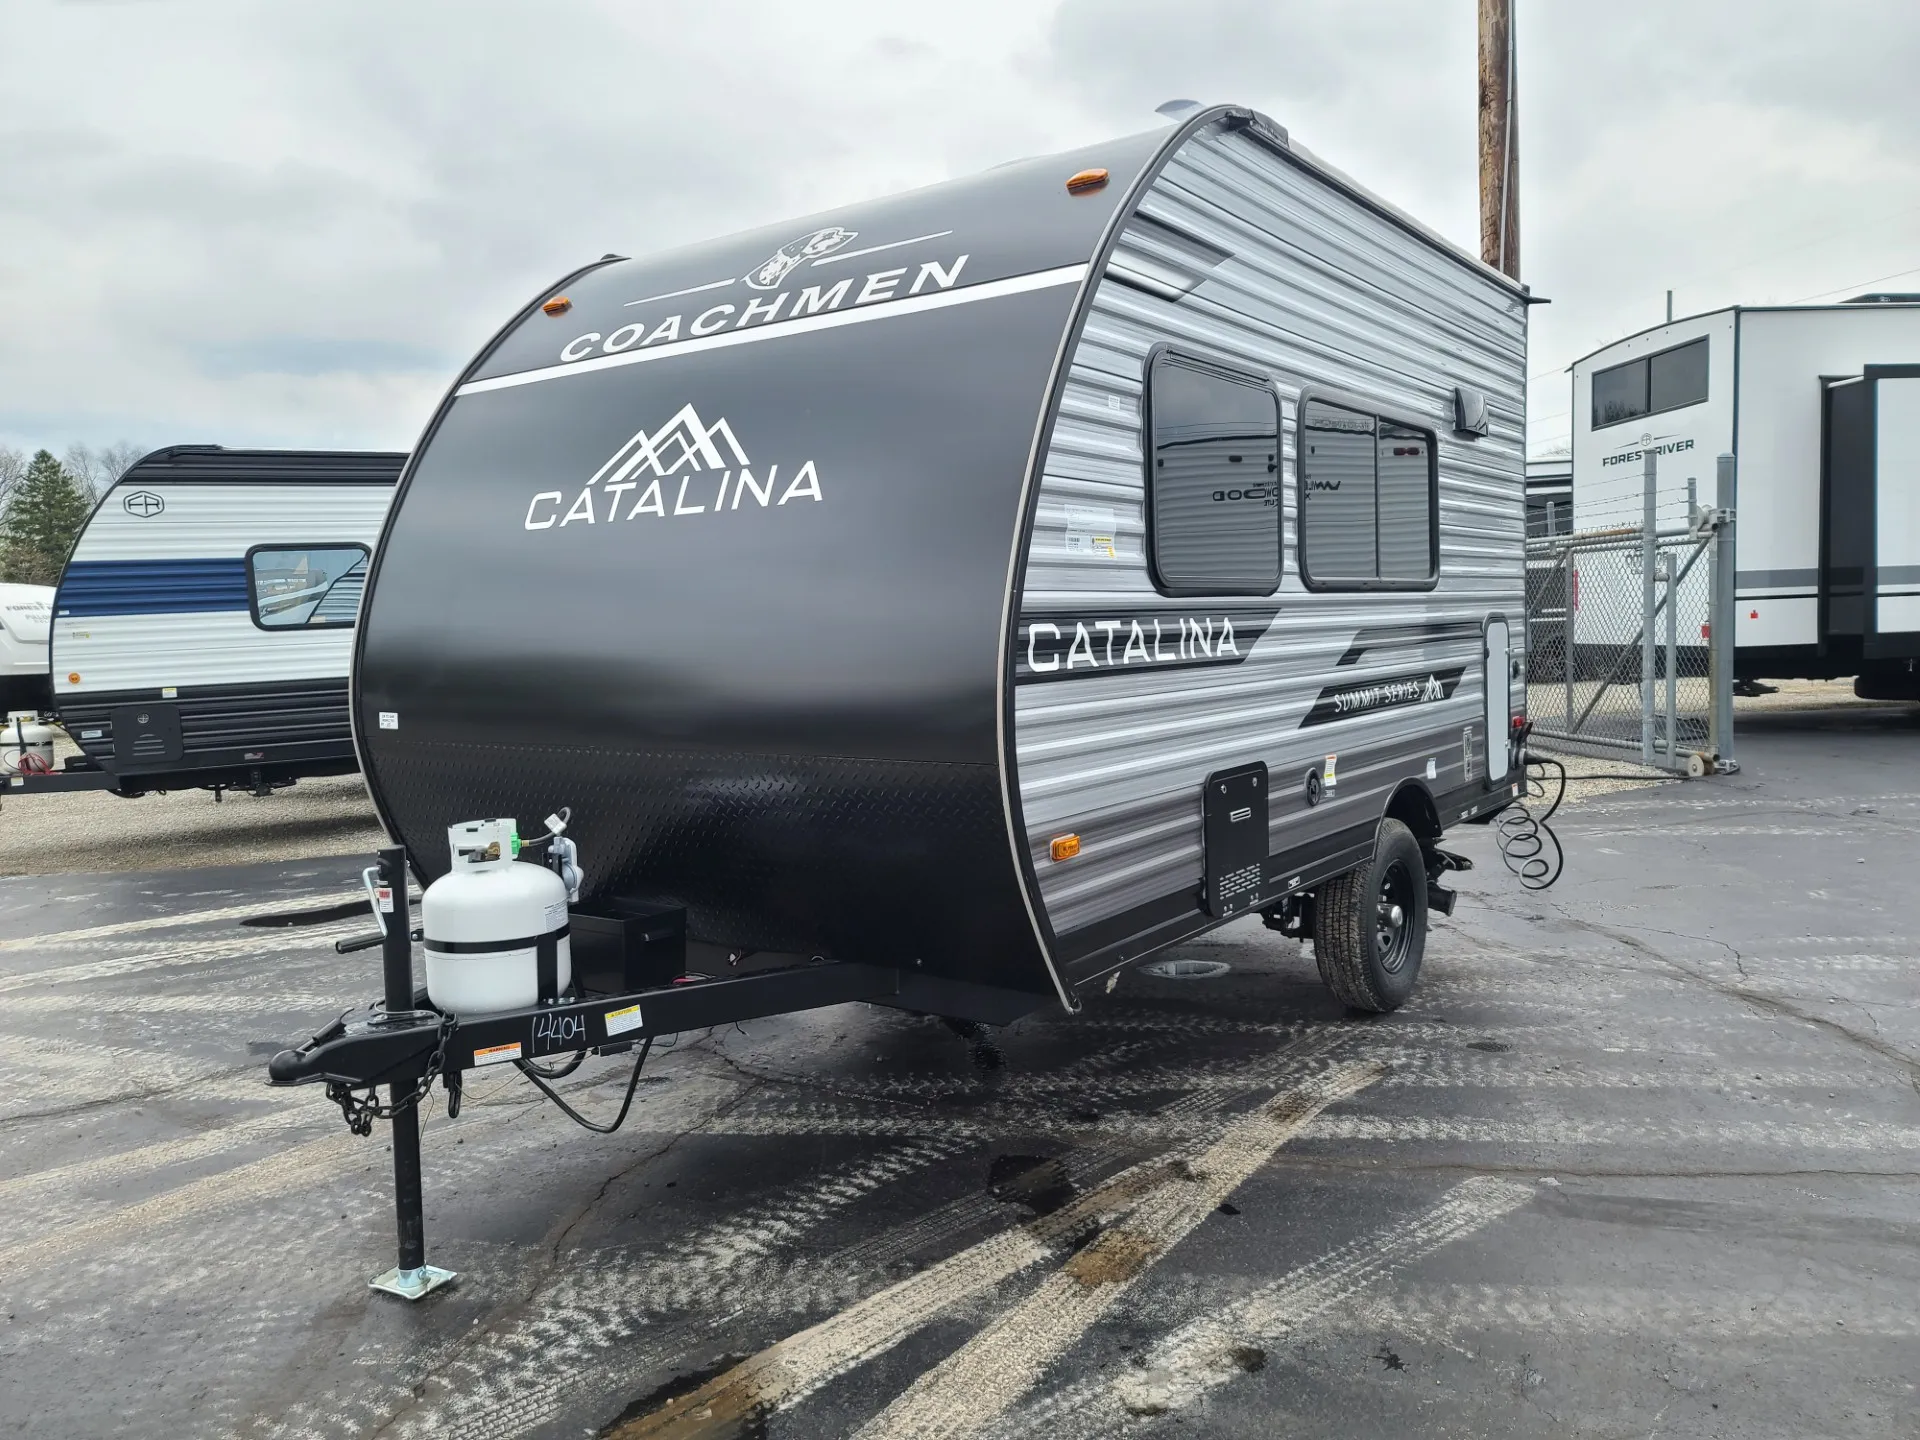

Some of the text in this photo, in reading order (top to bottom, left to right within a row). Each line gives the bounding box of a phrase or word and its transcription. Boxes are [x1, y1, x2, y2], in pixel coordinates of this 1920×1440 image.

[560, 254, 971, 362] COACHMEN
[1602, 450, 1644, 467] FORES
[523, 460, 823, 530] CATALINA
[1027, 617, 1240, 672] CATALINA
[1334, 681, 1420, 712] SUMMIT SERIES
[531, 1012, 587, 1054] 14404
